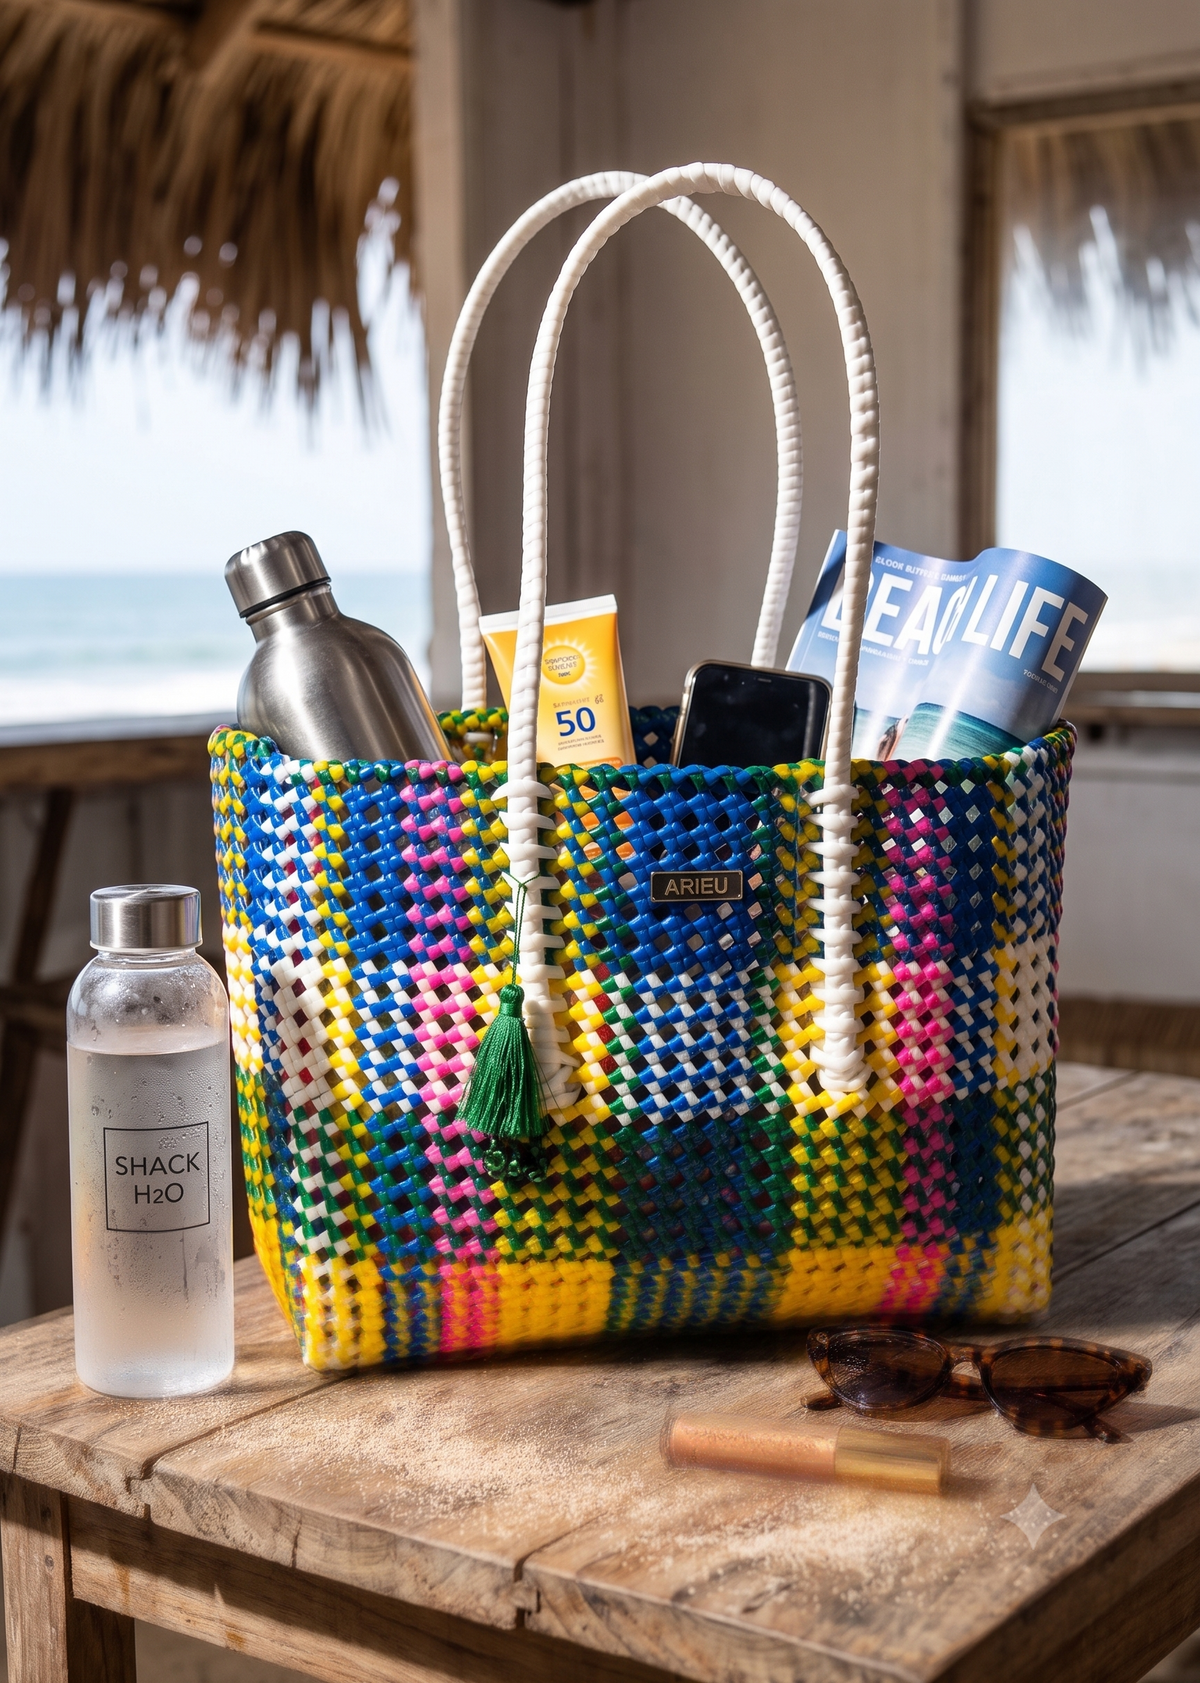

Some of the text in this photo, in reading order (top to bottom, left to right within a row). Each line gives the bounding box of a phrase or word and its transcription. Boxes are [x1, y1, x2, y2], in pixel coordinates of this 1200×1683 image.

[961, 574, 1089, 682] LIFE
[556, 706, 596, 737] 50
[664, 877, 728, 896] ARIEU
[115, 1152, 200, 1176] SHACK
[134, 1182, 184, 1204] H2O
